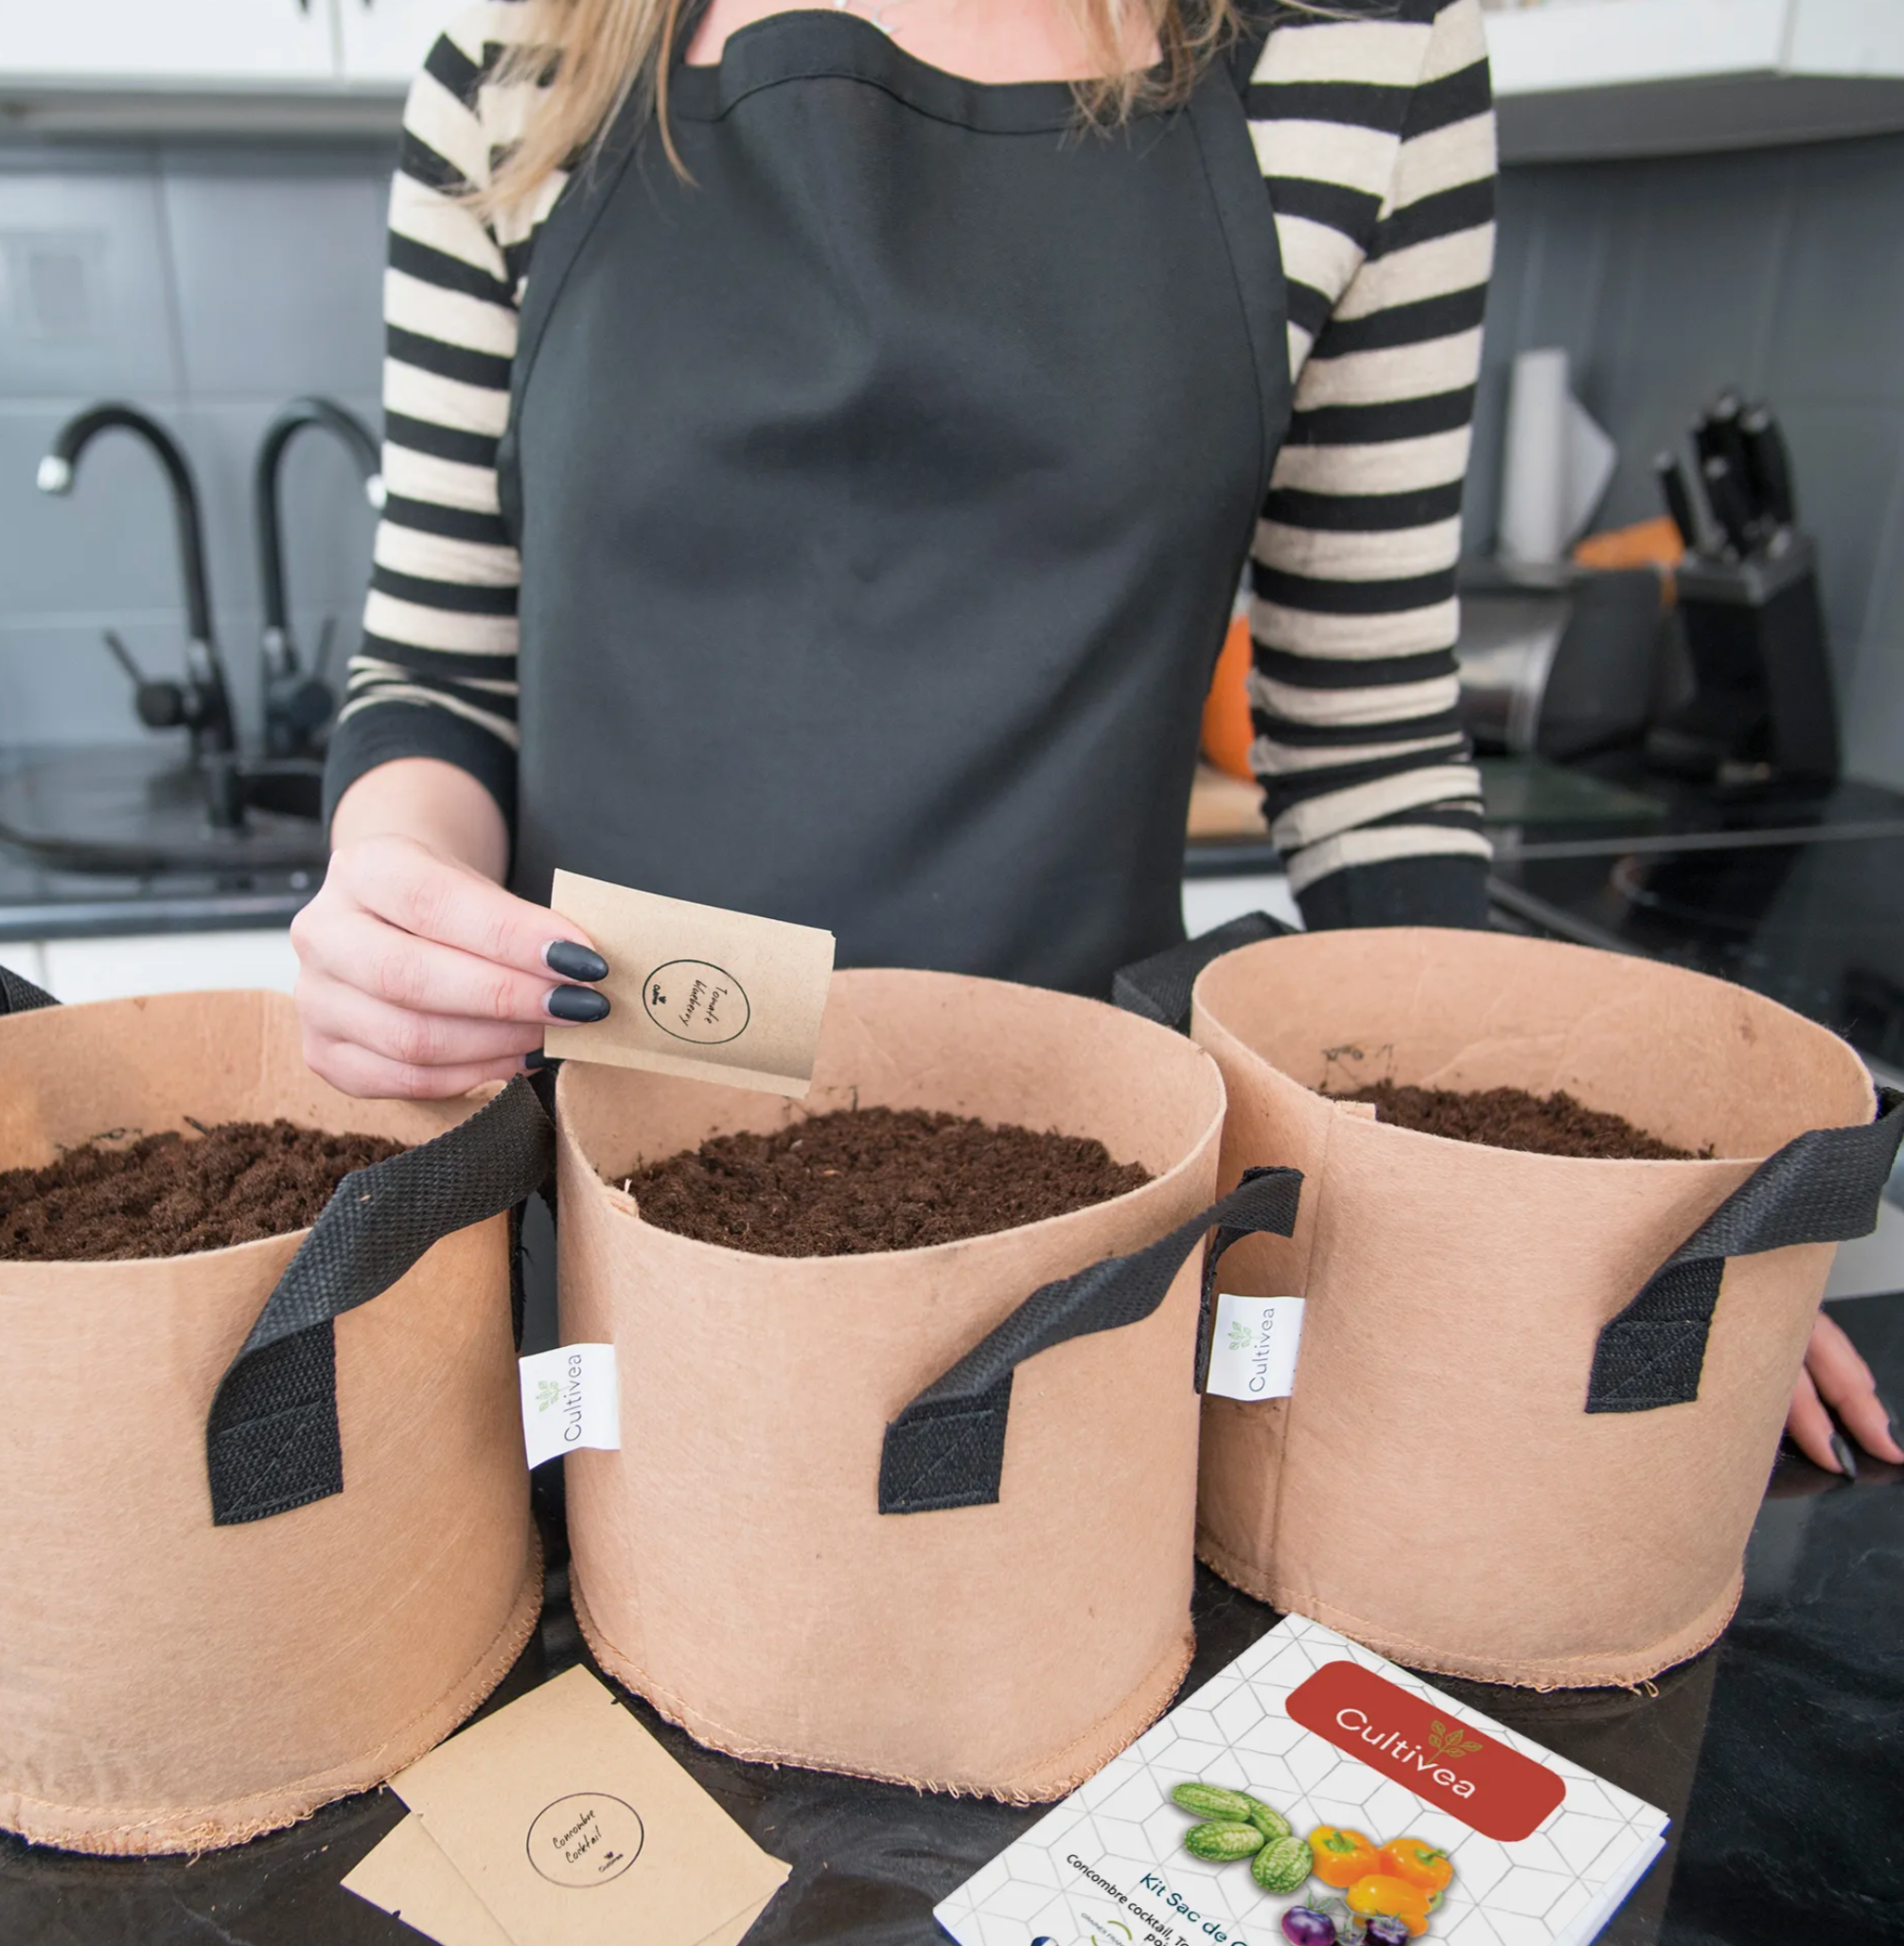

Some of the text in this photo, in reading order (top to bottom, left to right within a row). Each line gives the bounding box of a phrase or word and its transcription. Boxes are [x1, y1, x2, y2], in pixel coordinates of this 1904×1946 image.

[704, 986, 728, 1024] Tomate
[1249, 1308, 1275, 1392] Cultivea
[563, 1354, 582, 1442] Cultivea
[1336, 1708, 1476, 1798] Cultivea
[553, 1810, 596, 1849] Concombre
[1066, 1853, 1128, 1904] Concombre
[1128, 1902, 1173, 1940] cocktail,
[1139, 1872, 1228, 1943] Kit Sac de
